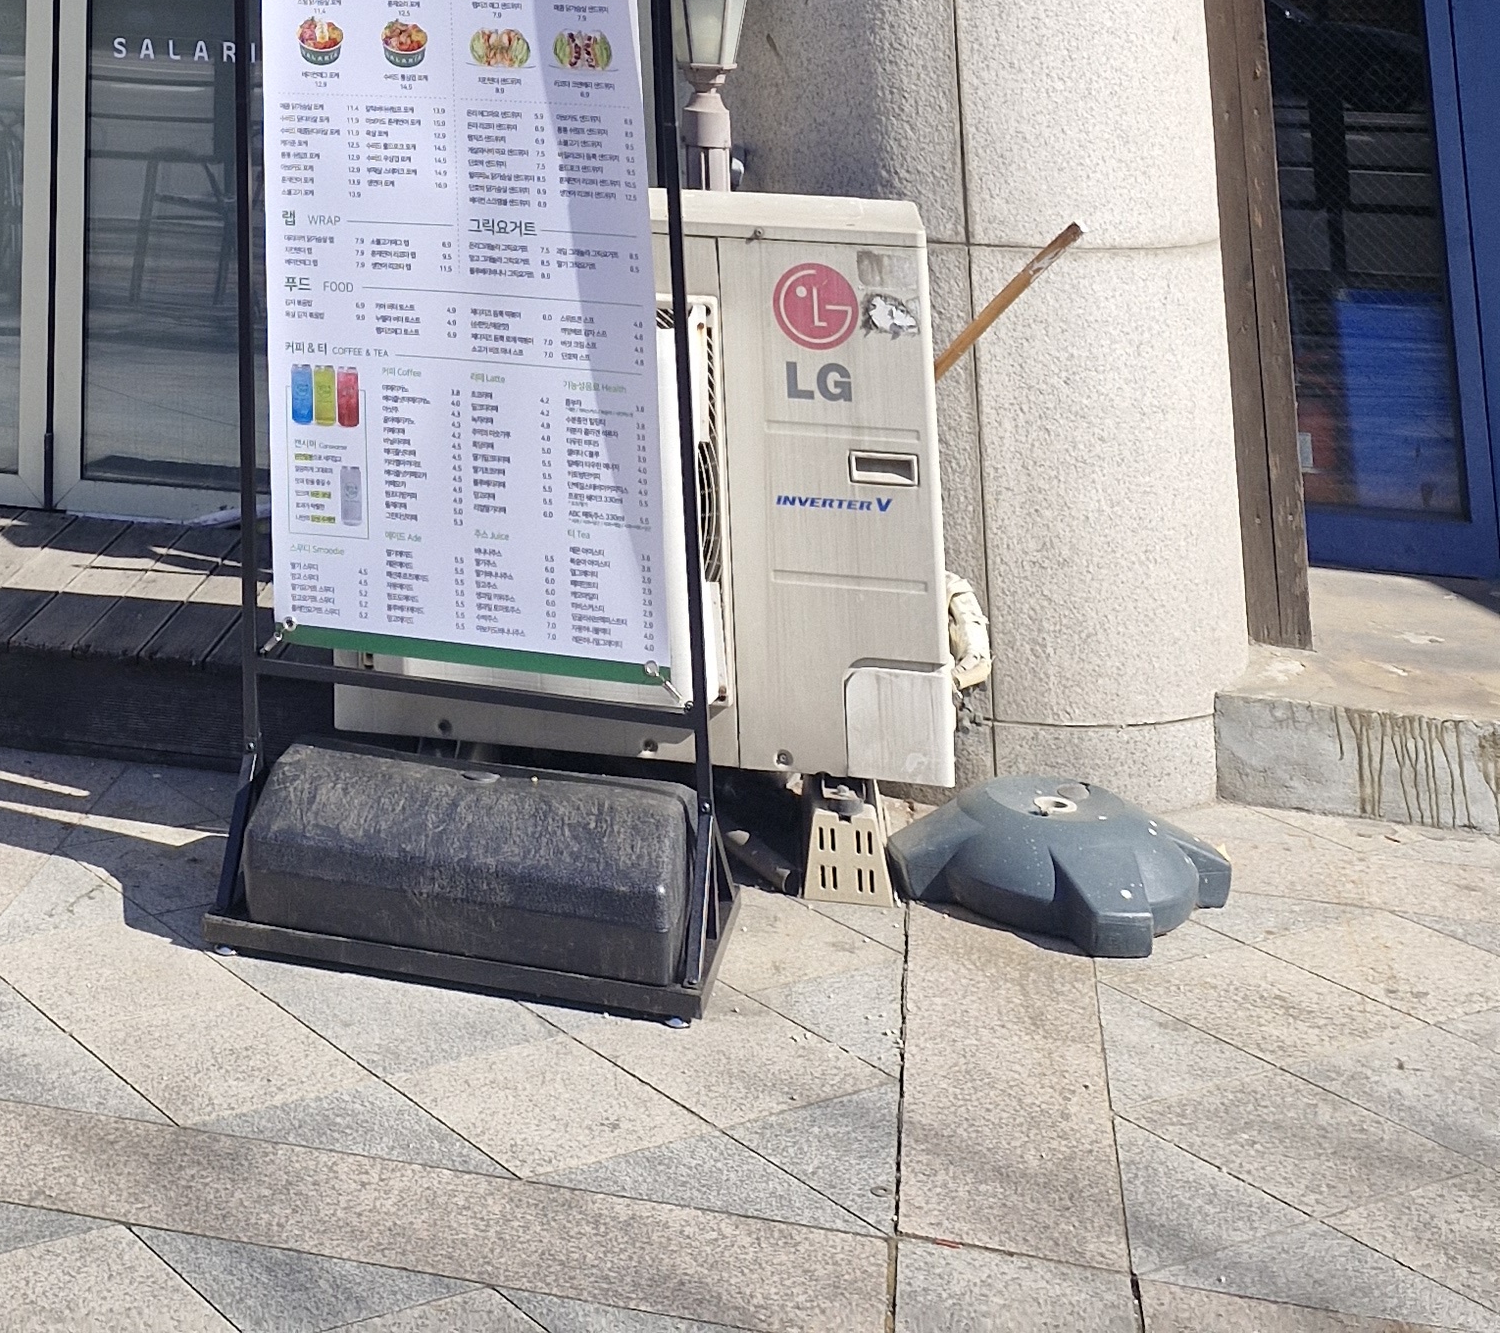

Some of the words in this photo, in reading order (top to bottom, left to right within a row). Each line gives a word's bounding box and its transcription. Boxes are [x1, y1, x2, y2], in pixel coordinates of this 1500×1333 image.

[112, 37, 257, 65] SALARI
[282, 210, 296, 227] 랩
[308, 215, 341, 226] WRAP
[467, 218, 538, 237] 그릭요거트
[284, 276, 312, 293] 푸드
[323, 281, 354, 293] FOOD
[285, 341, 305, 355] 커피
[307, 342, 316, 353] &
[317, 342, 328, 355] 티
[332, 346, 363, 357] COFFEE
[373, 348, 389, 358] TEA
[397, 367, 422, 378] Coffee
[785, 360, 853, 402] LG
[776, 494, 872, 512] INVERTER
[875, 497, 893, 513] V
